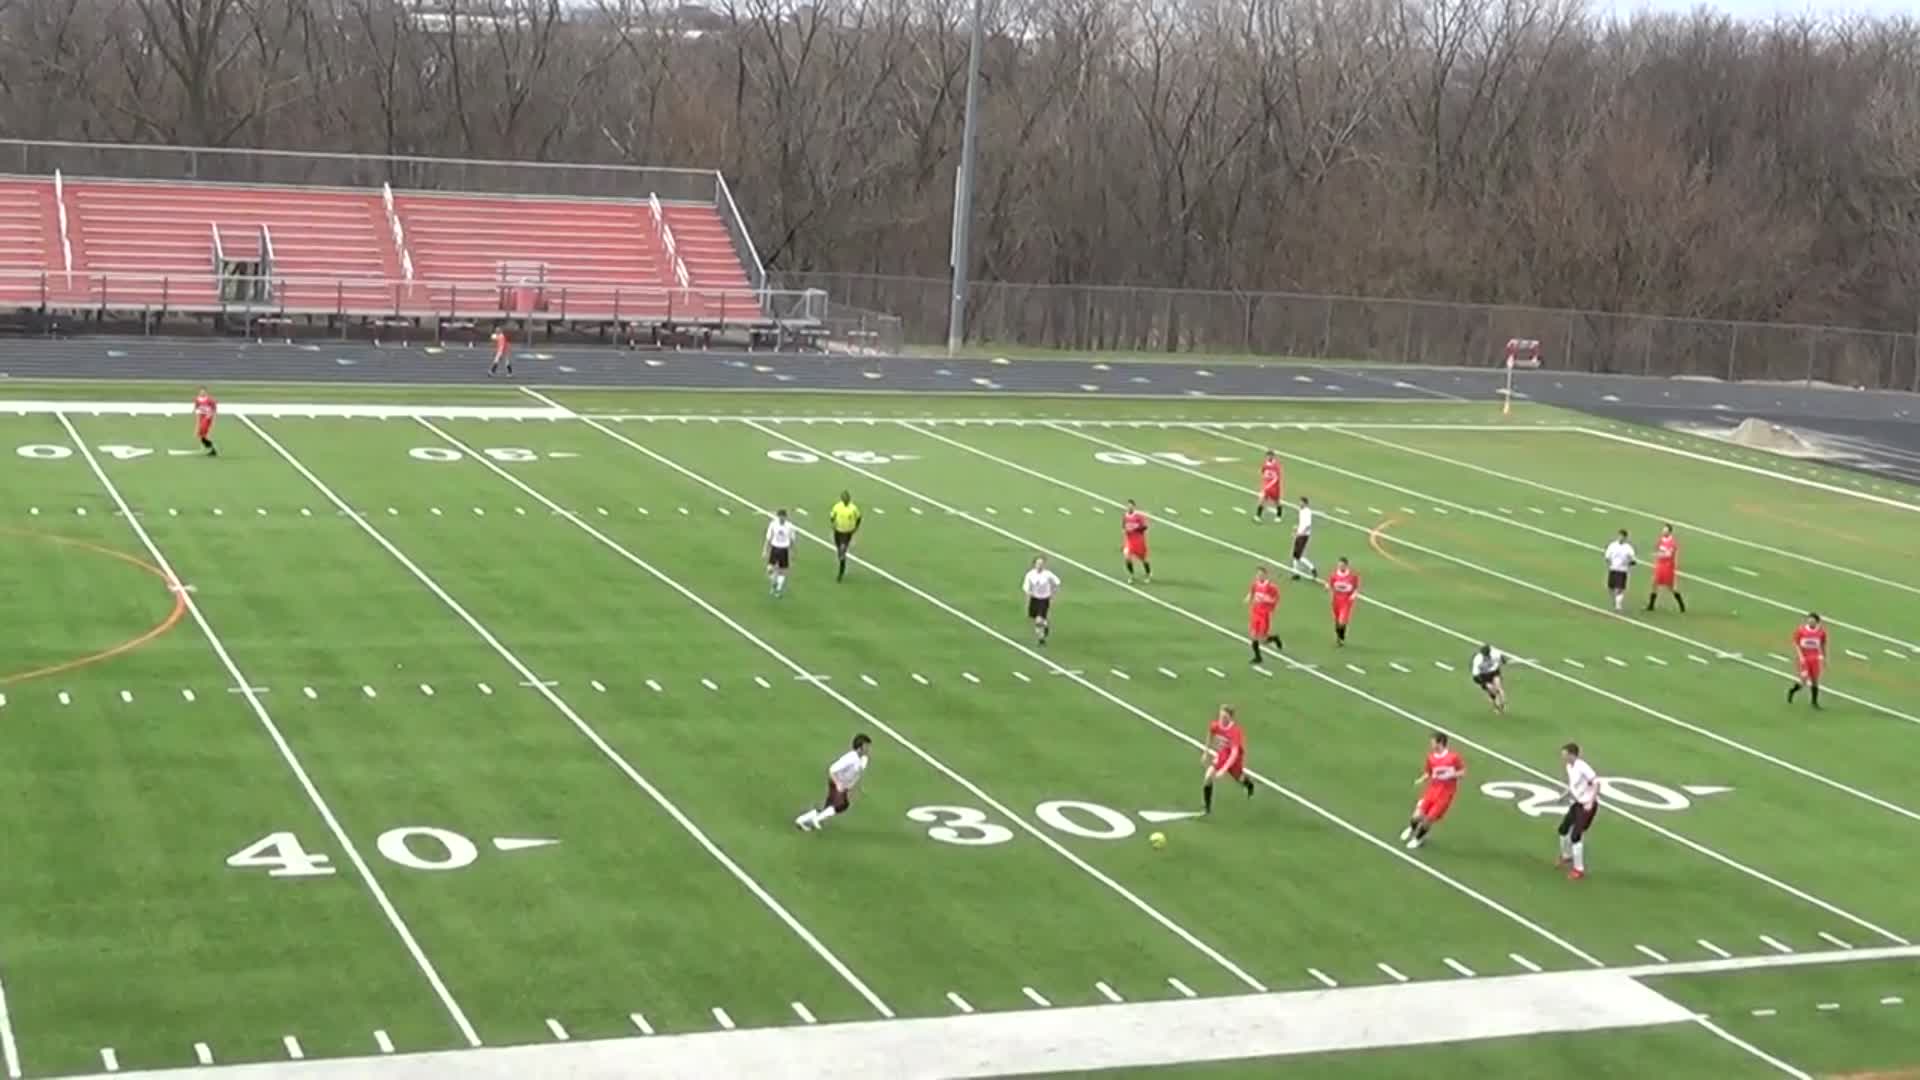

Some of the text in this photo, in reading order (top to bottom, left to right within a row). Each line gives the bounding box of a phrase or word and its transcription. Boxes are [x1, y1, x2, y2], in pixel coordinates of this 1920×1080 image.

[1481, 776, 1691, 817] 20
[906, 799, 1137, 846] 30
[227, 826, 478, 877] 40
